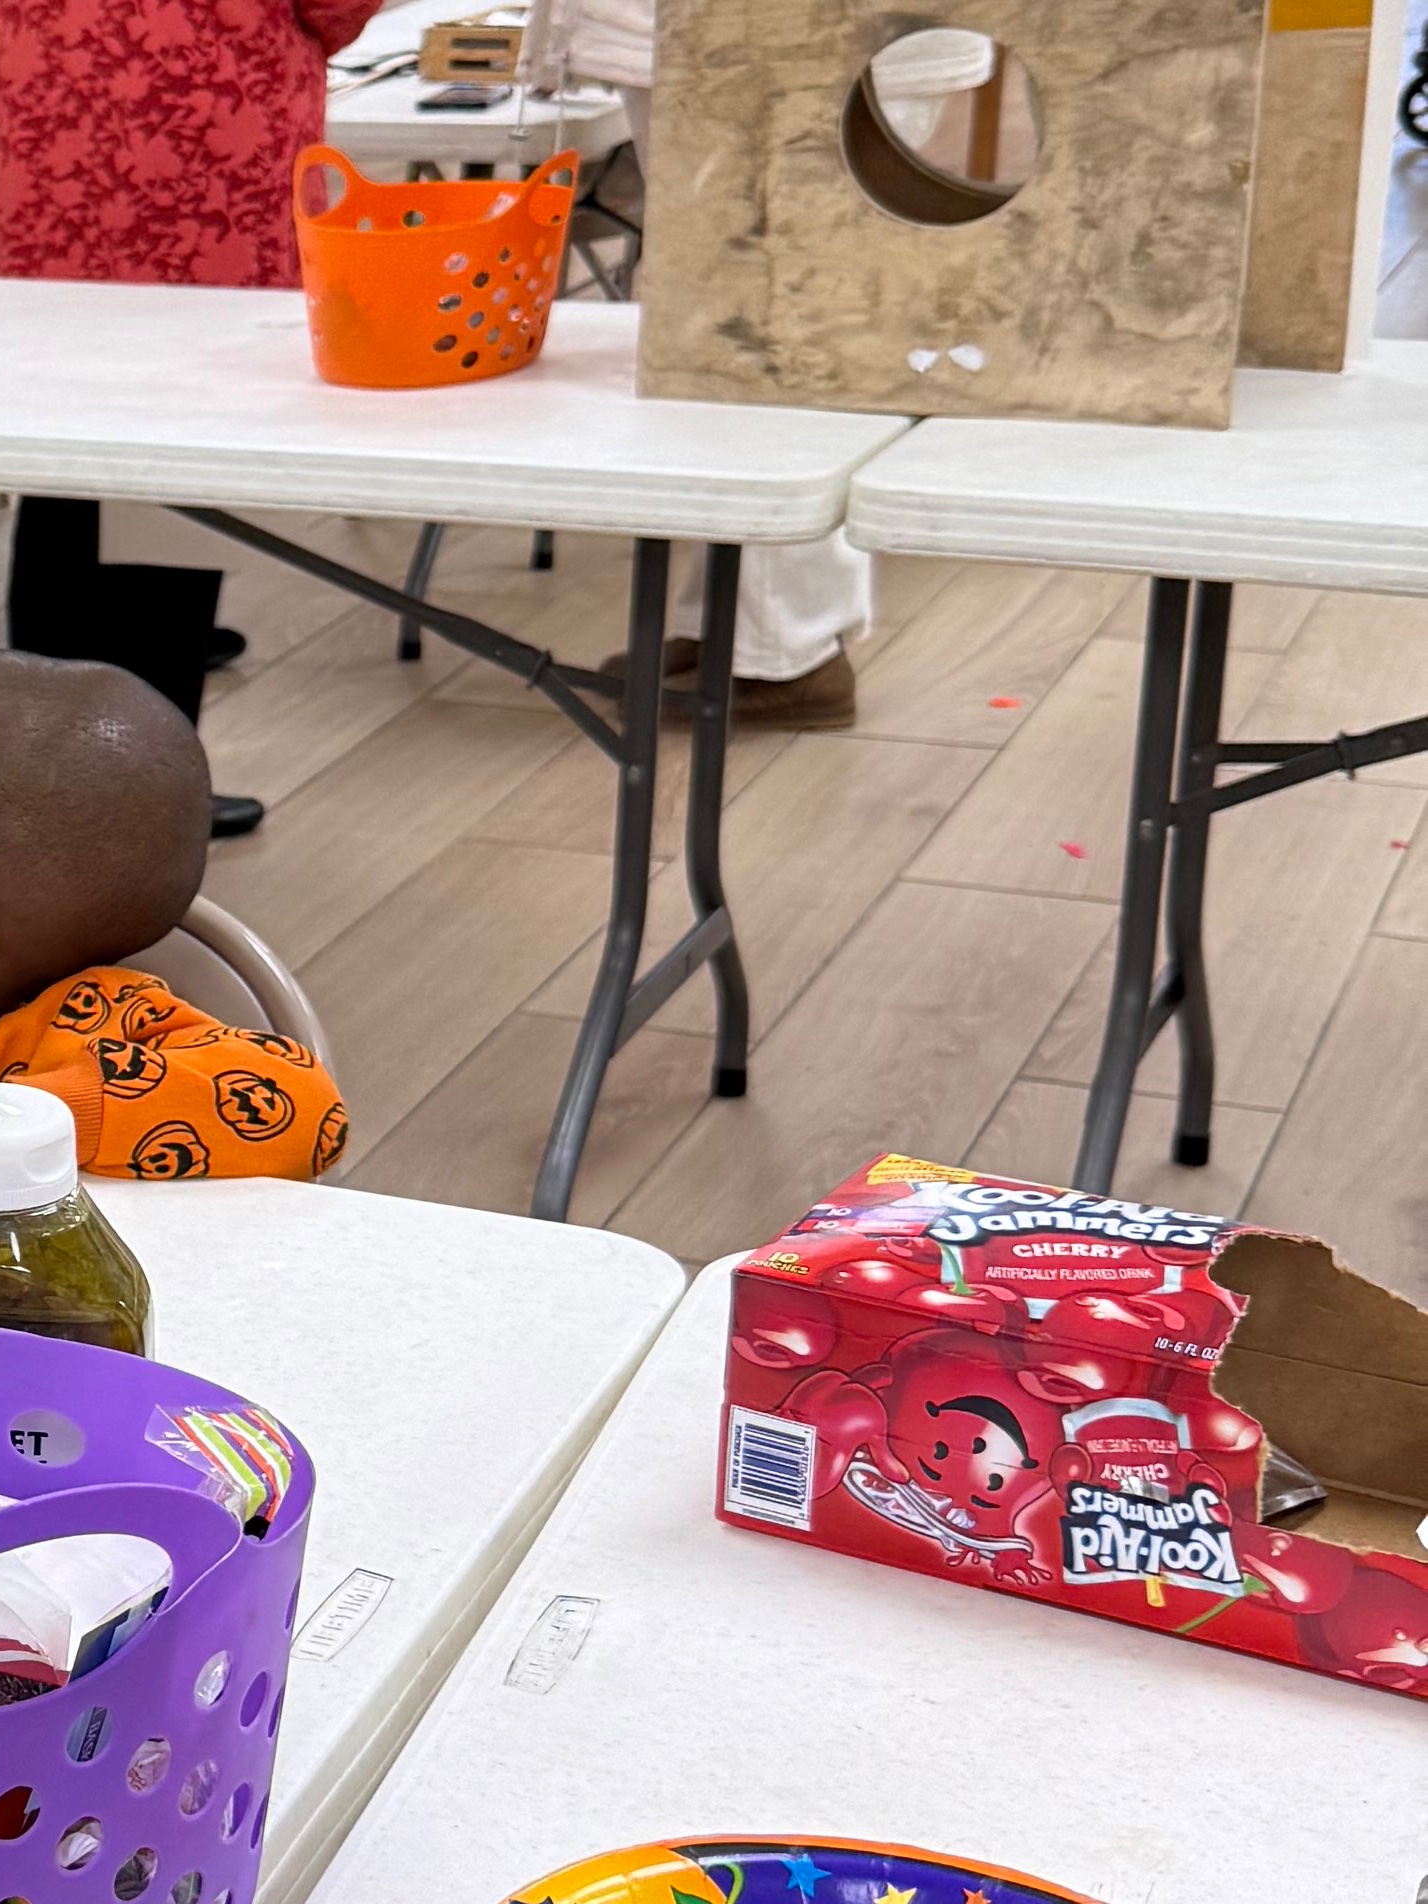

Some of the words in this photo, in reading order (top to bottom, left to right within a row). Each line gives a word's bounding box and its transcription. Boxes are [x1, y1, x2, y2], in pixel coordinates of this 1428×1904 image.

[929, 1210, 1219, 1244] Jammers
[768, 1251, 800, 1265] 10
[1012, 1242, 1131, 1259] CHERRY
[747, 1258, 809, 1276] POUCHES
[985, 1266, 1057, 1281] ARTIFICIALLY
[1059, 1267, 1117, 1281] FLAVORED
[1118, 1267, 1156, 1280] DRINK
[1100, 1462, 1170, 1482] CHERRY
[1070, 1487, 1219, 1530] Jammers
[1070, 1514, 1242, 1583] Kool-Aid
